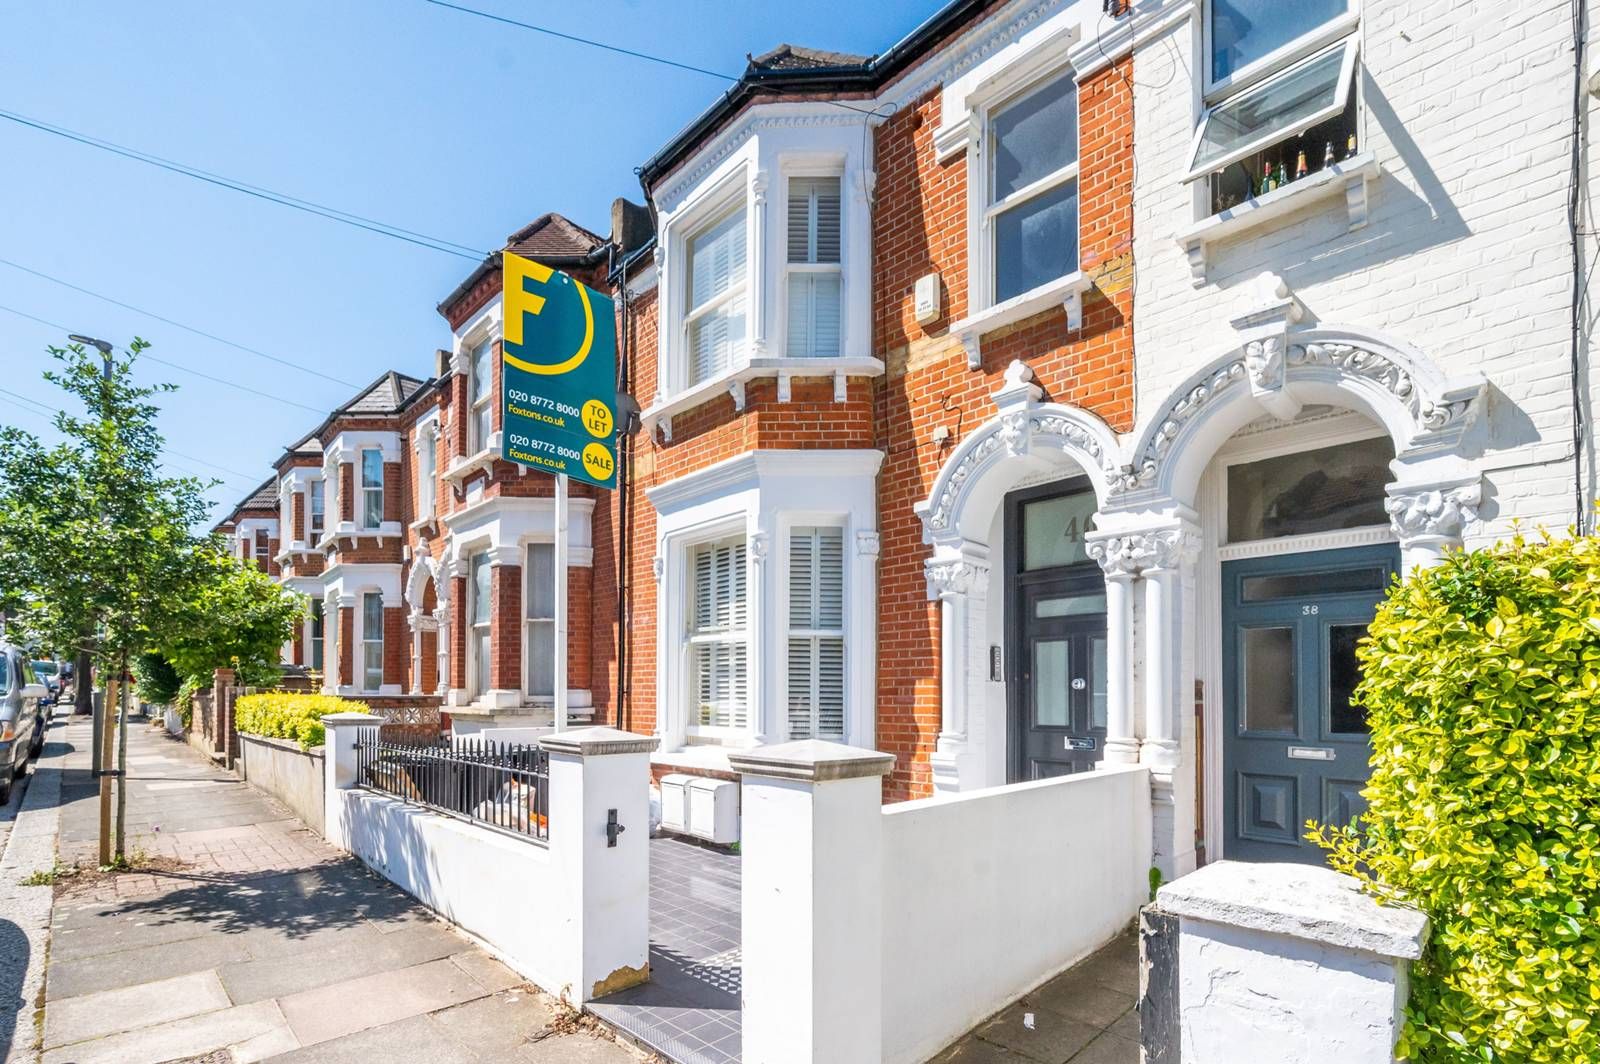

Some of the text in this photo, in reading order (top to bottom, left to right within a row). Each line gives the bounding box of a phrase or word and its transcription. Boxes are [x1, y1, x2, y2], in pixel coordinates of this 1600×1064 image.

[508, 388, 580, 417] 020 8772 8000
[590, 404, 606, 419] TO
[508, 403, 565, 427] Foxtons.co.uk
[588, 418, 607, 433] LET
[509, 434, 581, 461] 020 8772 8000
[509, 448, 566, 470] Foxtons.co.uk
[585, 453, 612, 471] SALE
[1302, 605, 1319, 616] 38
